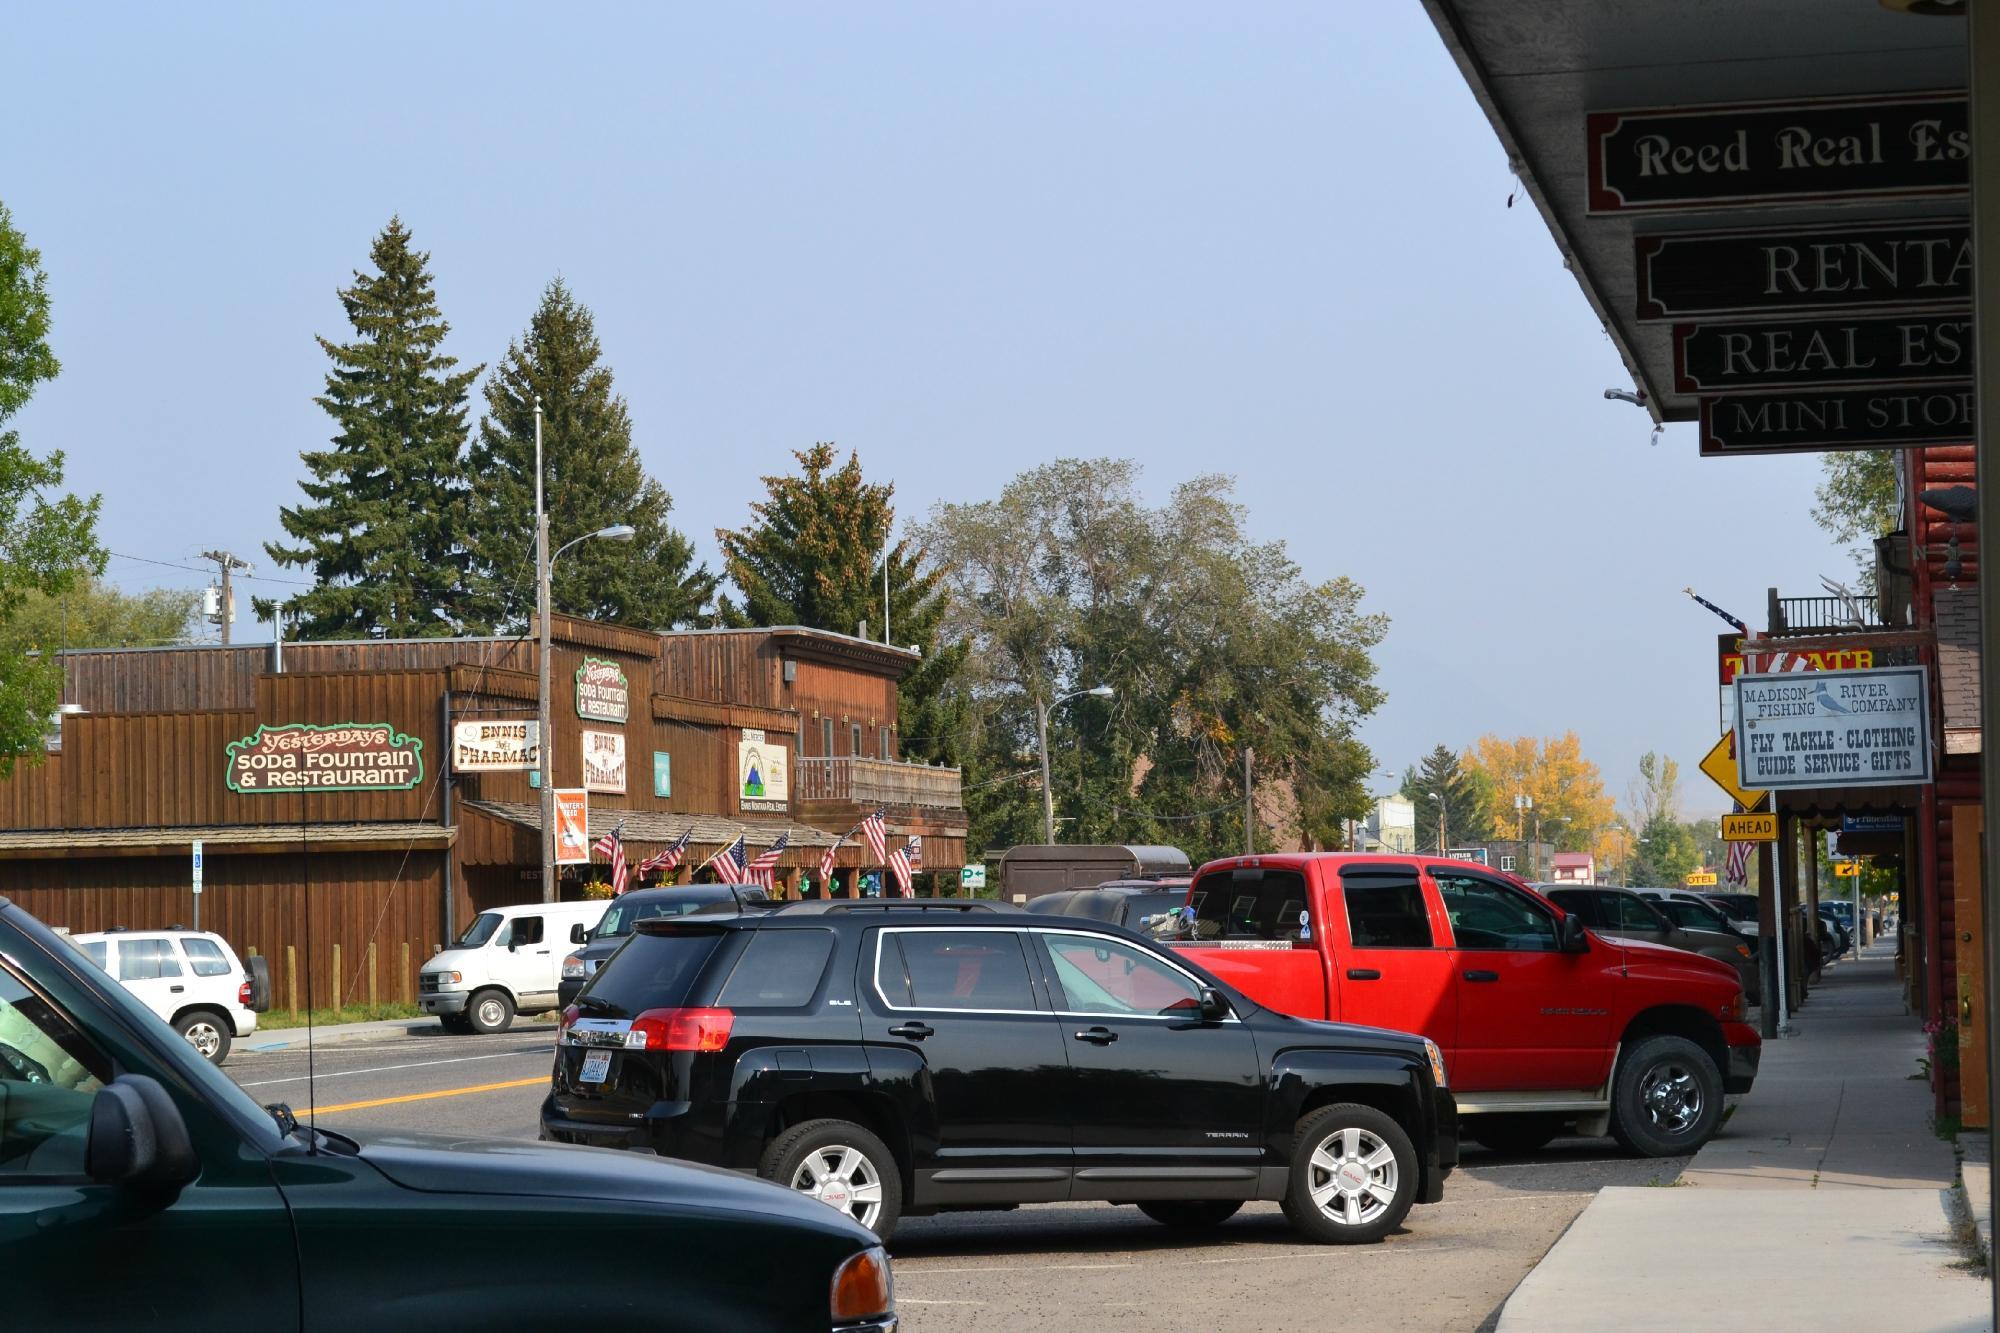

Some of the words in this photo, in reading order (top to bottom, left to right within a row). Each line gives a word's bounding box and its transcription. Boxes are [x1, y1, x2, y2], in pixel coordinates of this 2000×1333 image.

[1634, 129, 1750, 177] Reed
[1774, 123, 1886, 169] Real
[1718, 327, 1877, 375] REAL
[1733, 400, 1849, 433] MINI
[1744, 687, 1808, 704] MADISON
[1839, 683, 1889, 699] RIVER
[1757, 701, 1816, 718] FISHING
[1851, 697, 1918, 713] COMPANY
[480, 725, 527, 740] ENNIS
[1750, 733, 1775, 754] FLY
[1782, 730, 1835, 752] TACKLE
[1847, 727, 1916, 750] CLOTHING
[594, 734, 616, 753] ENNIS
[459, 744, 543, 765] PHARMAC
[1757, 755, 1796, 776] GUIDE
[1804, 752, 1861, 774] SERVICE
[1871, 750, 1912, 771] GIFTS
[240, 772, 257, 787] &
[585, 759, 624, 787] PHARMACY
[1728, 820, 1772, 834] AHEAD
[1204, 1131, 1250, 1139] TERRAIN
[1343, 1170, 1363, 1184] GMC
[824, 1192, 846, 1201] GMC
